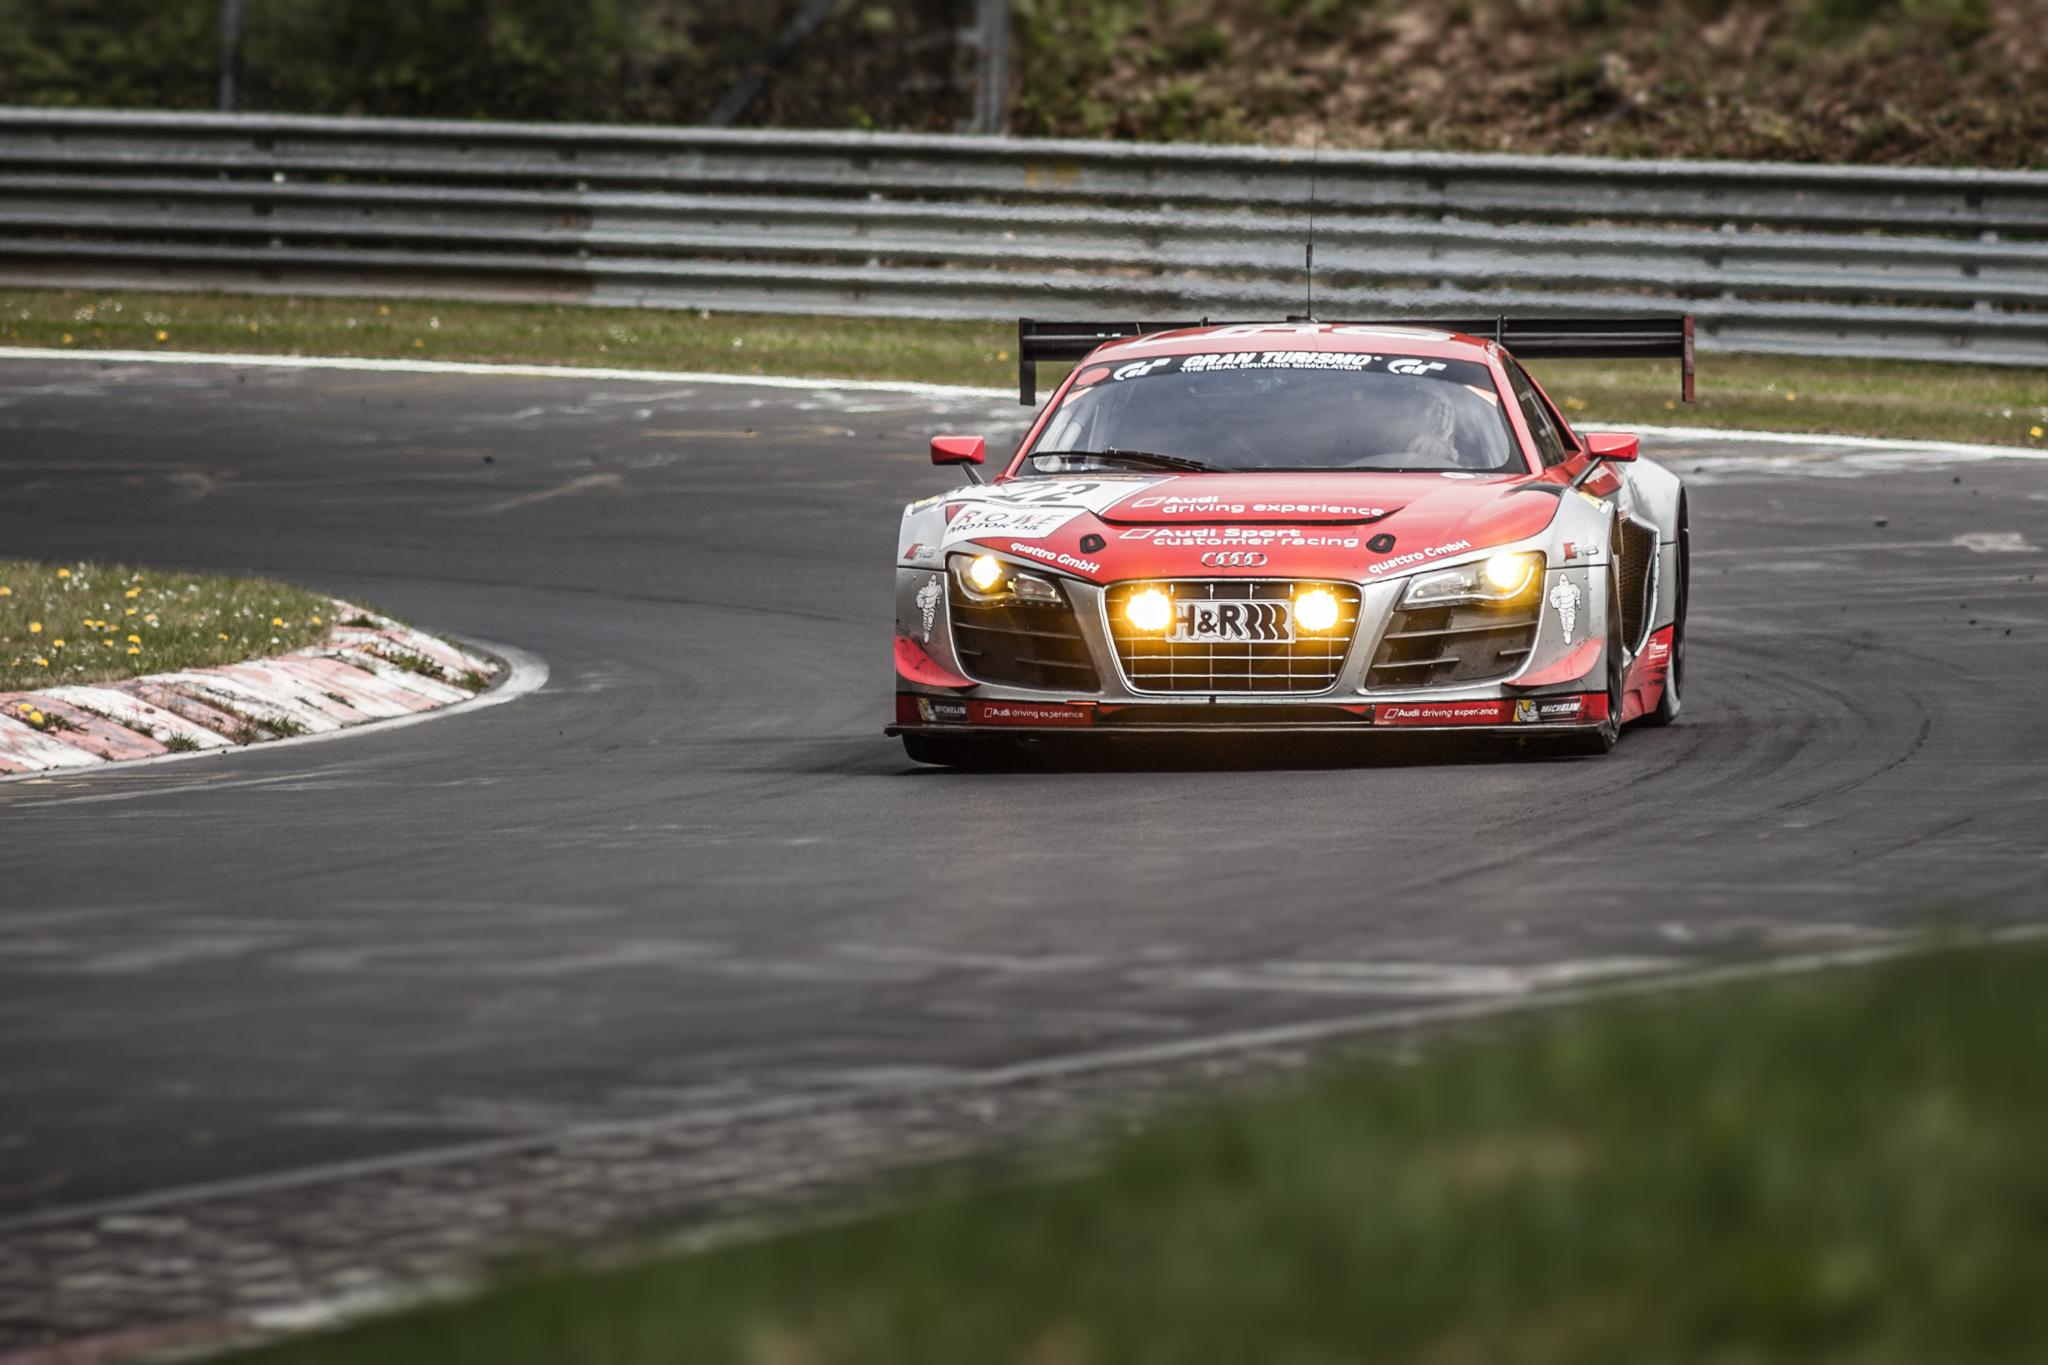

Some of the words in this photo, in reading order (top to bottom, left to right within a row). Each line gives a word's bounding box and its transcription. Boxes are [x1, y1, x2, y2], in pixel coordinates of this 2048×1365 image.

[1182, 352, 1257, 367] GRAN
[1261, 351, 1372, 366] TURISMO
[1180, 365, 1204, 373] THE
[1206, 363, 1237, 371] REAL
[1292, 362, 1362, 371] SIMULATOR
[1163, 496, 1219, 504] Audi
[1162, 503, 1246, 514] driving
[1252, 504, 1385, 517] experience
[947, 522, 1011, 535] MOTOR
[1014, 522, 1041, 532] OIL
[1153, 528, 1217, 537] Audi
[1223, 528, 1302, 538] Sport
[1152, 537, 1274, 546] customer
[1280, 537, 1360, 548] racing
[1010, 541, 1057, 562] quattro
[1056, 551, 1102, 574] GmbH
[1368, 550, 1425, 575] quattro
[1424, 539, 1473, 557] GmbH
[1398, 709, 1420, 717] Audi
[1422, 709, 1452, 719] driving
[1454, 707, 1499, 718] experience
[1540, 702, 1581, 713] MICHELIN
[992, 709, 1011, 717] Audi
[1012, 709, 1039, 719] driving
[1039, 709, 1084, 719] experience
